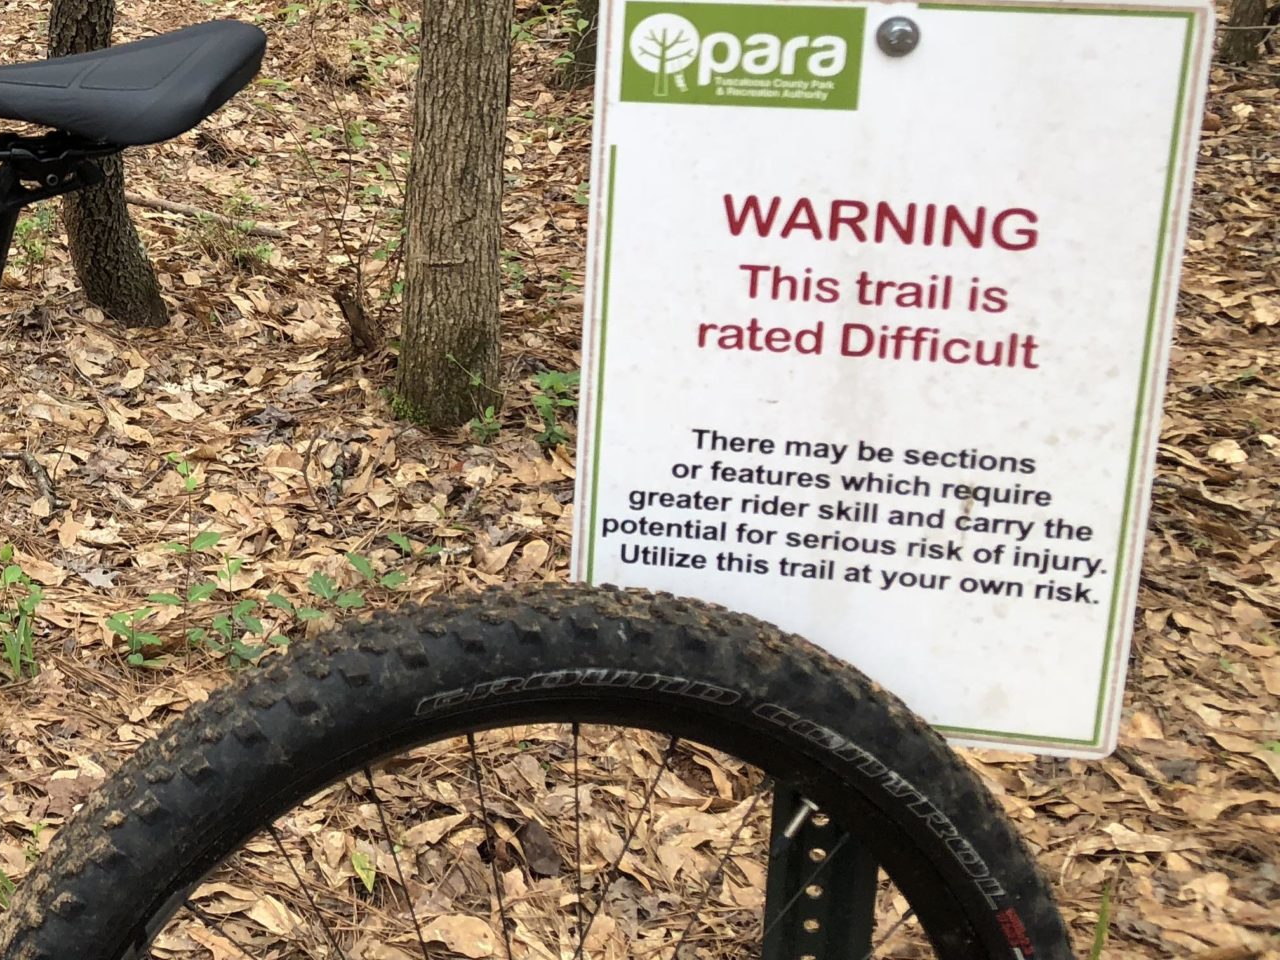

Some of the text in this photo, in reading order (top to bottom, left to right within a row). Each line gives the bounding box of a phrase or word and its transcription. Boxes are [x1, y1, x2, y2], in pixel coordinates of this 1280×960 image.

[697, 31, 847, 86] para
[715, 76, 835, 90] Tuscaloosa County Park
[726, 87, 781, 98] Recreation
[782, 88, 829, 101] Authority
[723, 194, 1038, 251] WARNING
[739, 264, 1008, 313] This trail is
[698, 318, 1039, 369] rated Difficult
[691, 428, 1036, 475] There may be sections
[671, 460, 1052, 508] or features which require
[628, 490, 1093, 542] greater rider skill and carry the
[602, 516, 1108, 579] potential for serious risk of injury.
[620, 543, 1100, 604] Utilize this trail at your own risk.
[413, 664, 1006, 912] GROUND CONTROL
